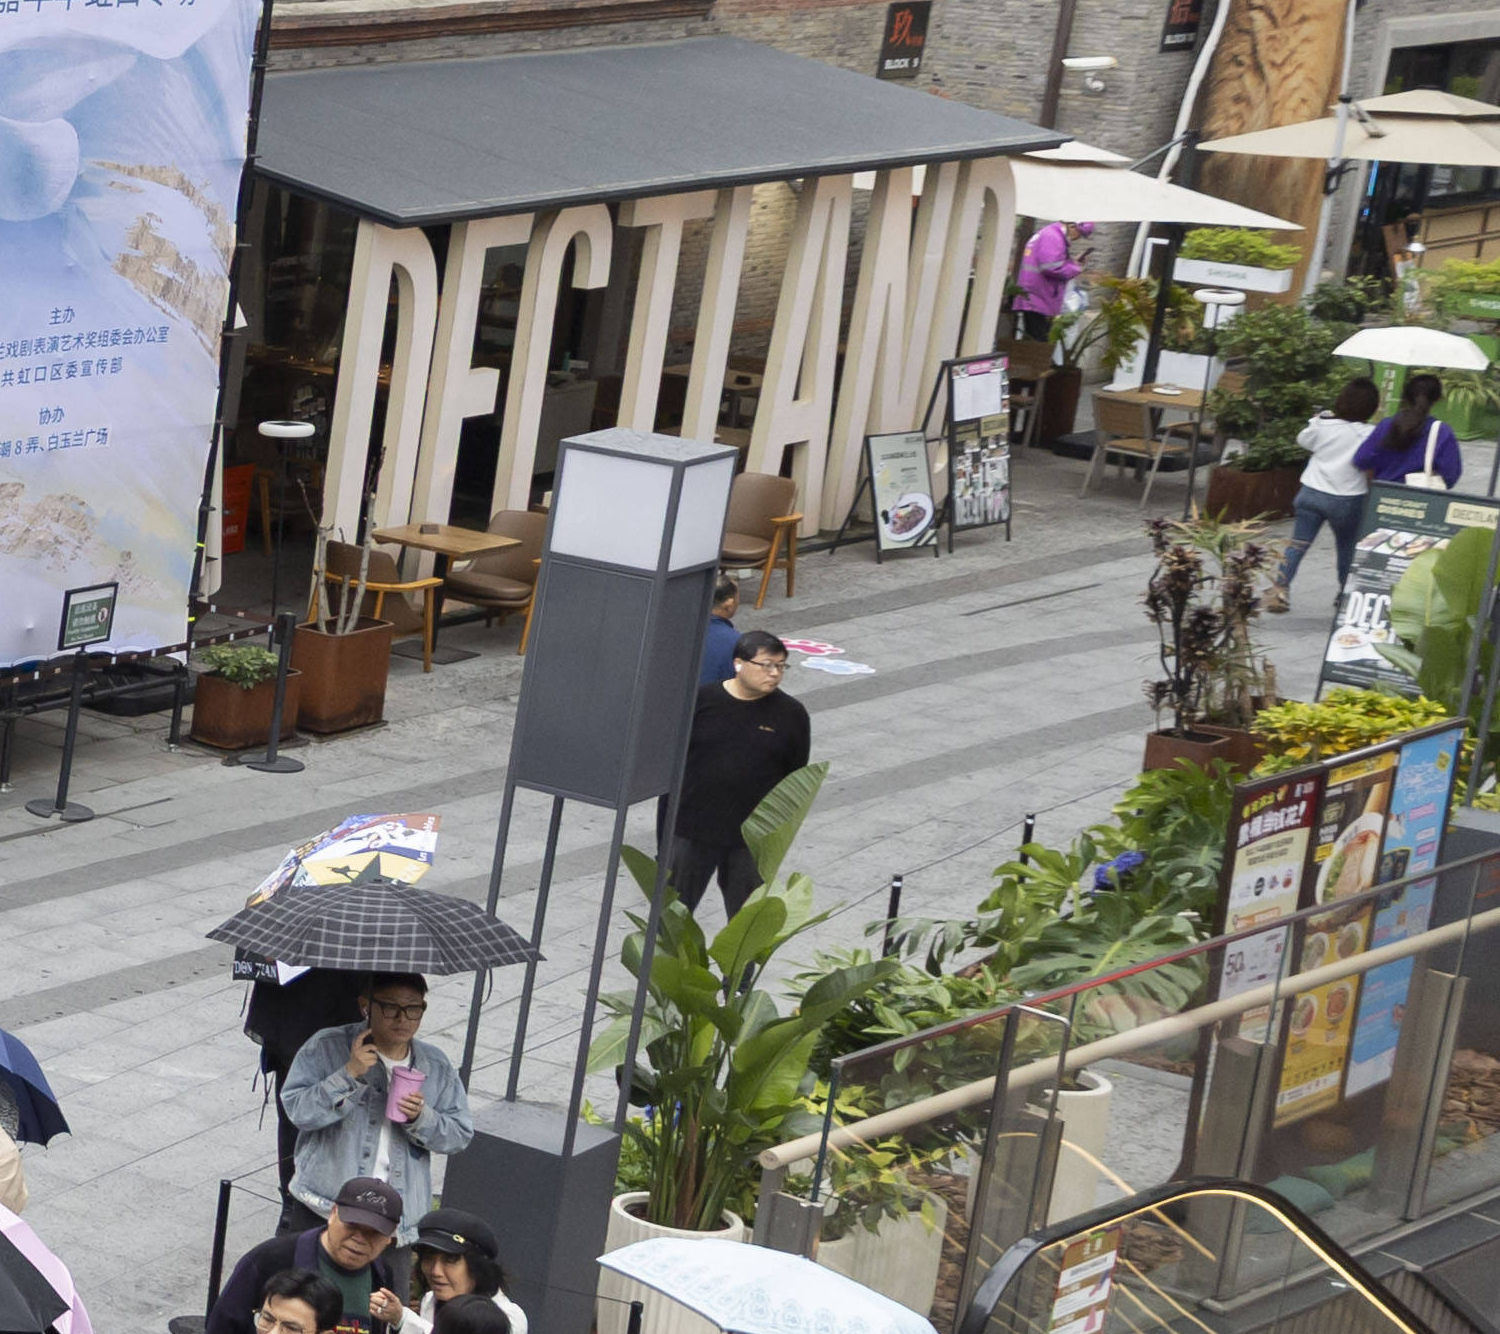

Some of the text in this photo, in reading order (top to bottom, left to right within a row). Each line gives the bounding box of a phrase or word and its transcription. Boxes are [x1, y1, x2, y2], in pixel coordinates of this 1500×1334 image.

[49, 306, 75, 325] 主办
[38, 406, 65, 425] 协办
[1343, 591, 1391, 629] DEC
[234, 960, 253, 975] DON
